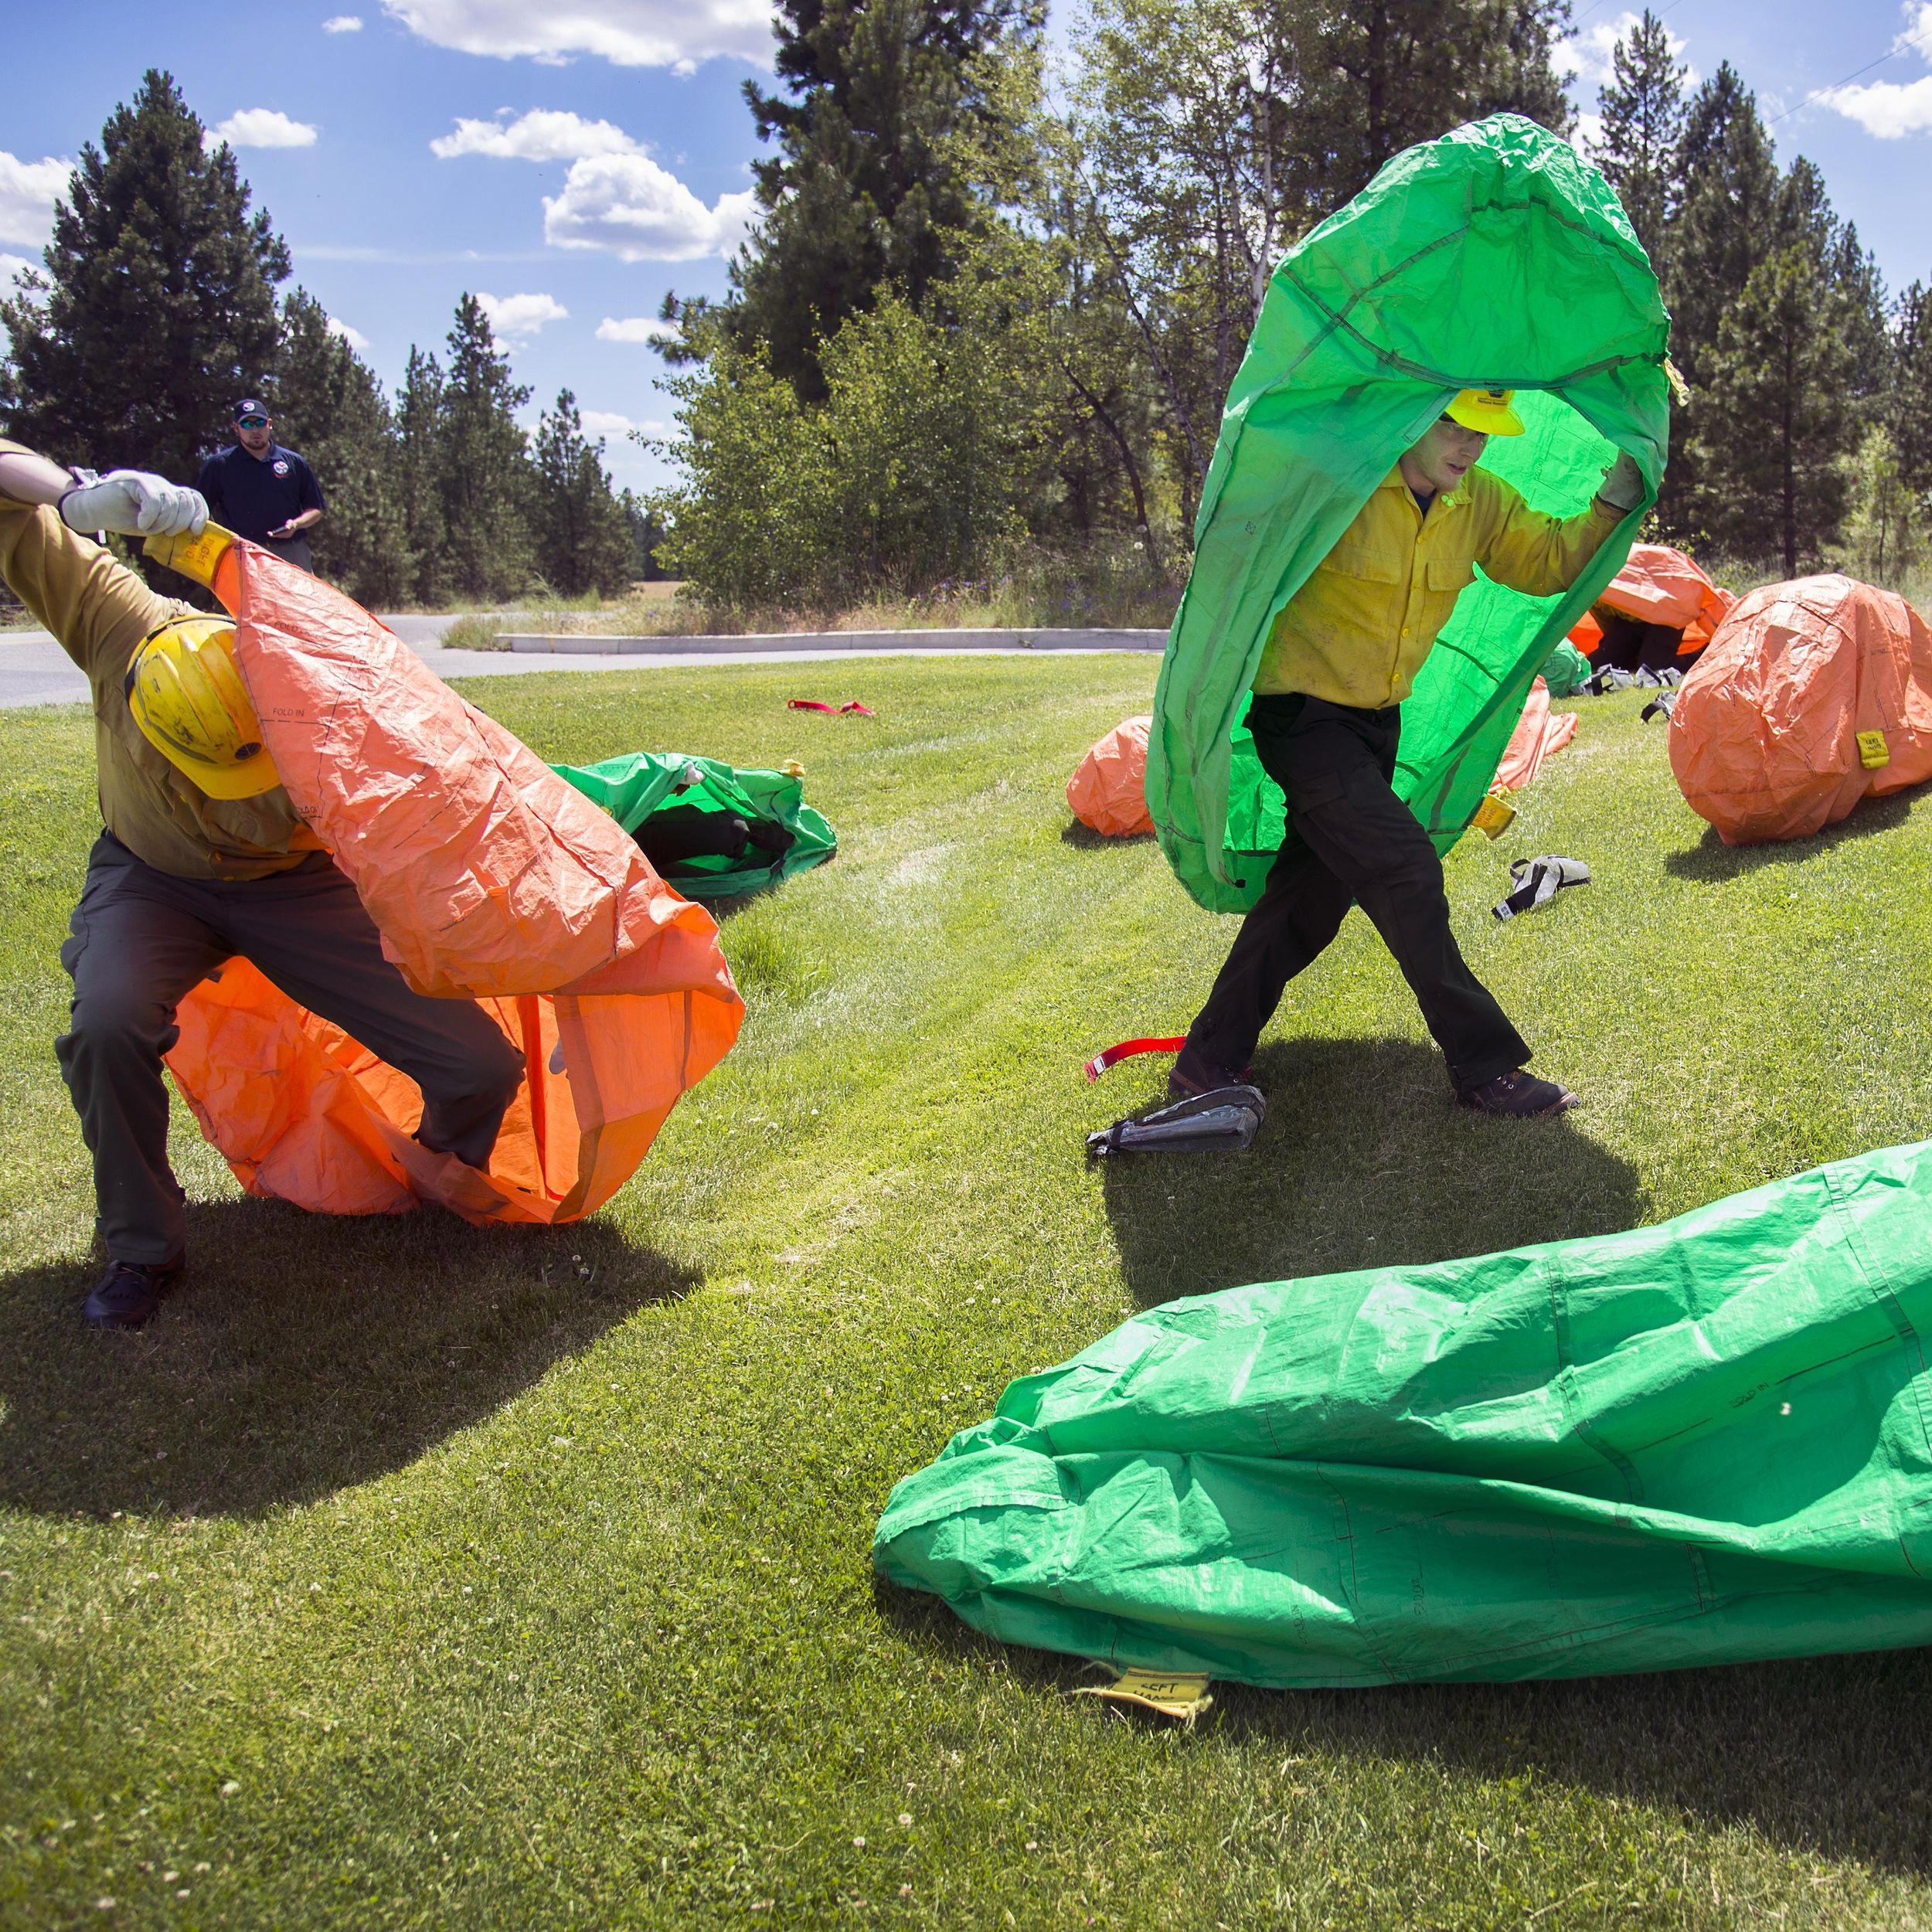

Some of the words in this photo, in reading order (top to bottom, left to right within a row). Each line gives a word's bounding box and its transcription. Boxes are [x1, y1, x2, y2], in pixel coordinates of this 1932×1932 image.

[197, 537, 215, 568] RIGHT
[274, 621, 298, 632] FOLD
[273, 707, 294, 717] FOLD
[295, 709, 305, 717] IN
[1141, 1682, 1179, 1693] LEFT
